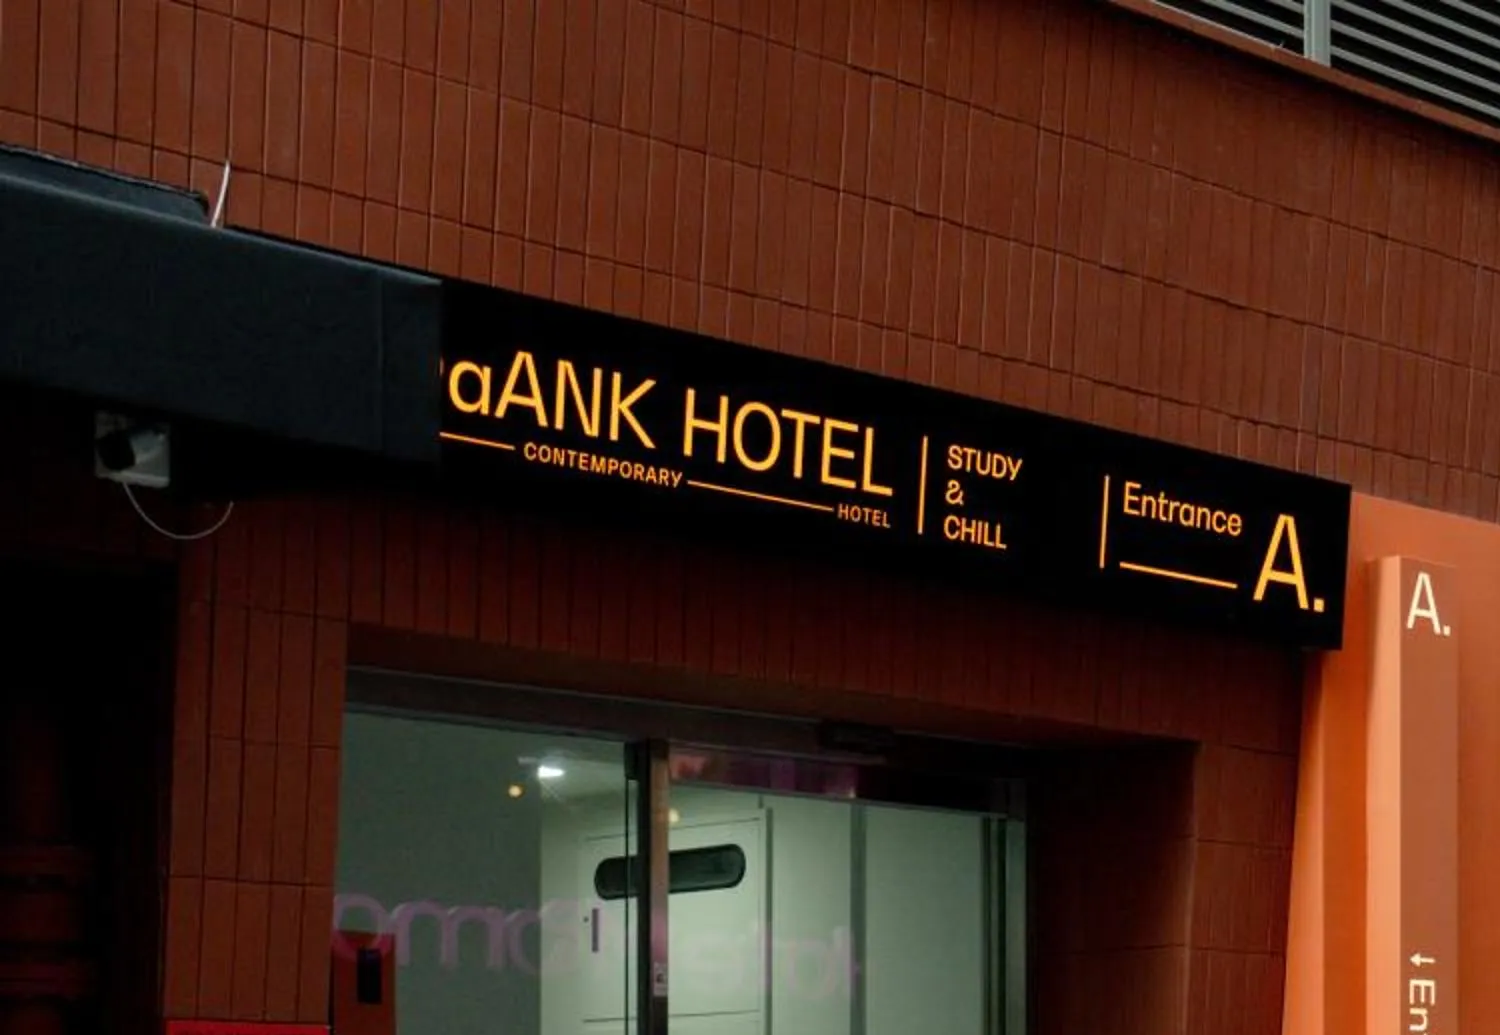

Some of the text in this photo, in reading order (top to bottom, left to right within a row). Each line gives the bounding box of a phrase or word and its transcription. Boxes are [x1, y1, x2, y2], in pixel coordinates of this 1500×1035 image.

[440, 350, 894, 497] aANK HOTEL
[523, 441, 684, 488] CONTEMPORARY
[947, 444, 1023, 481] STUDY
[837, 503, 892, 529] HOTEL
[944, 479, 964, 506] &
[1123, 480, 1243, 537] Entrance
[943, 514, 1008, 550] CHILL
[1252, 513, 1325, 613] A.
[1406, 571, 1451, 637] A.
